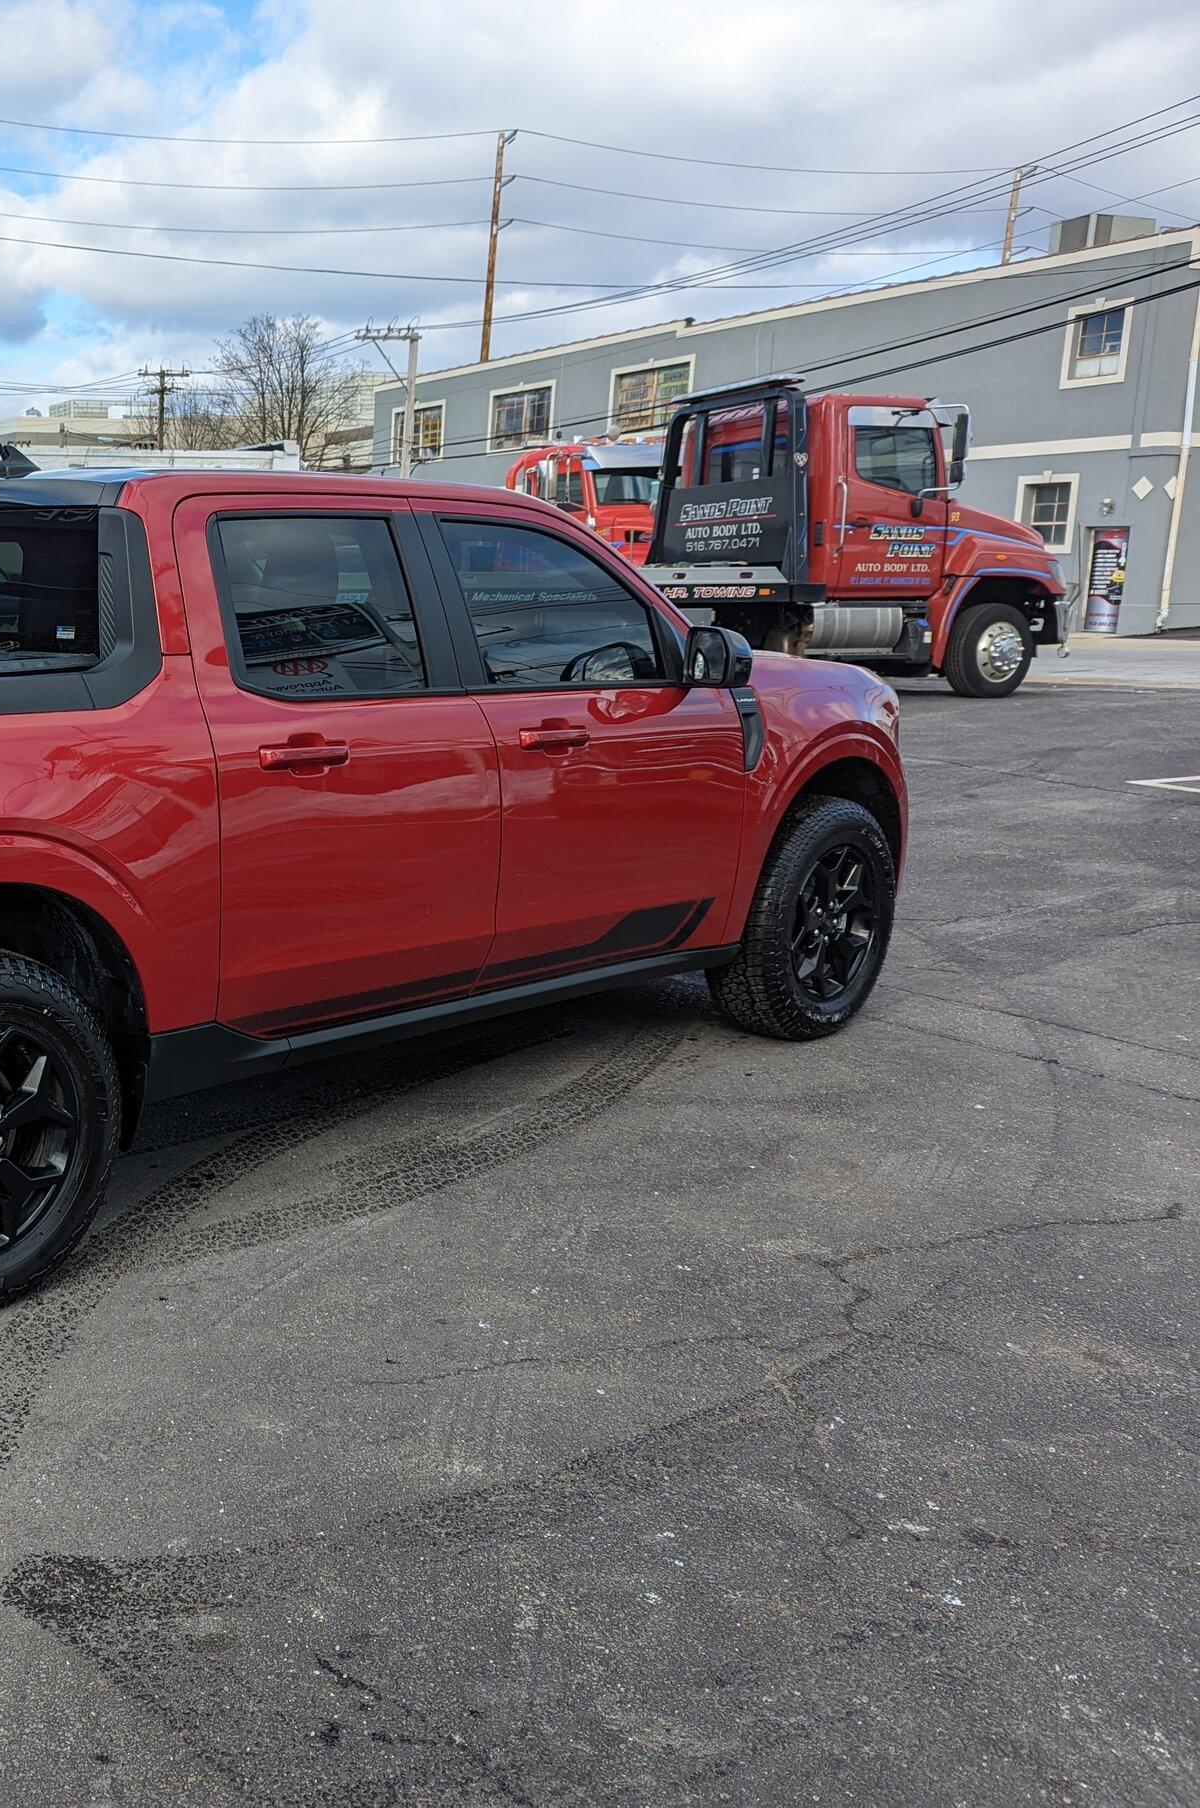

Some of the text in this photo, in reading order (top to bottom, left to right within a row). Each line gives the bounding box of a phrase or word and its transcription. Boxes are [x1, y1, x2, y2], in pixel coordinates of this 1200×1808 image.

[680, 497, 773, 521] SANDS POINT
[685, 522, 763, 540] AUTO BODY LTD.
[869, 525, 926, 540] SANDS
[686, 537, 760, 553] 516.767.0471
[886, 542, 936, 558] POINT
[855, 563, 930, 573] AUTO BODY LTD.
[472, 591, 598, 603] Mechanical Specialists
[693, 586, 756, 599] TOWING
